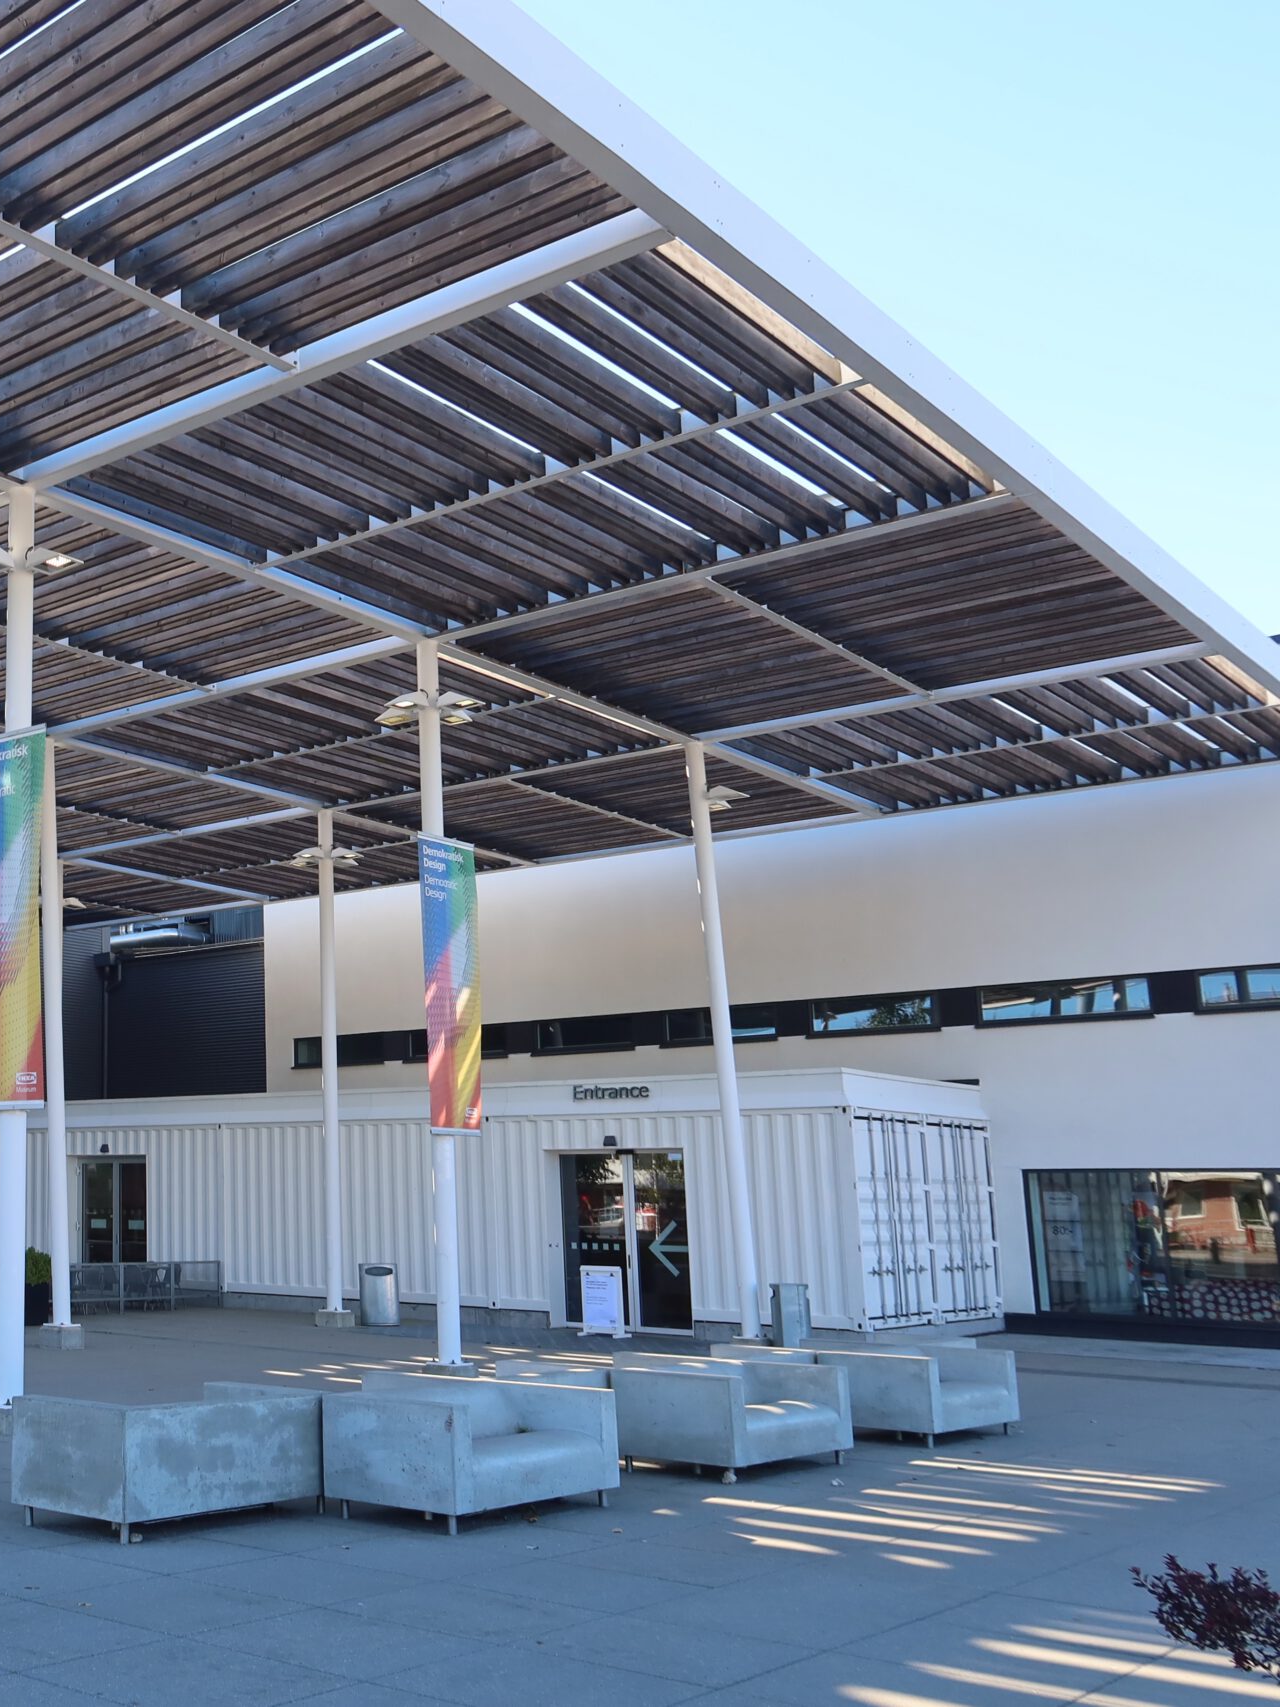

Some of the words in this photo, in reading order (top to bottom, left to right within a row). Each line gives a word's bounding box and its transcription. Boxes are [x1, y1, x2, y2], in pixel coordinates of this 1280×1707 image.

[423, 845, 464, 864] Demokratisk
[423, 857, 446, 872] Design
[424, 874, 458, 890] Democratic
[425, 887, 447, 902] Design
[573, 1085, 650, 1101] Entrance
